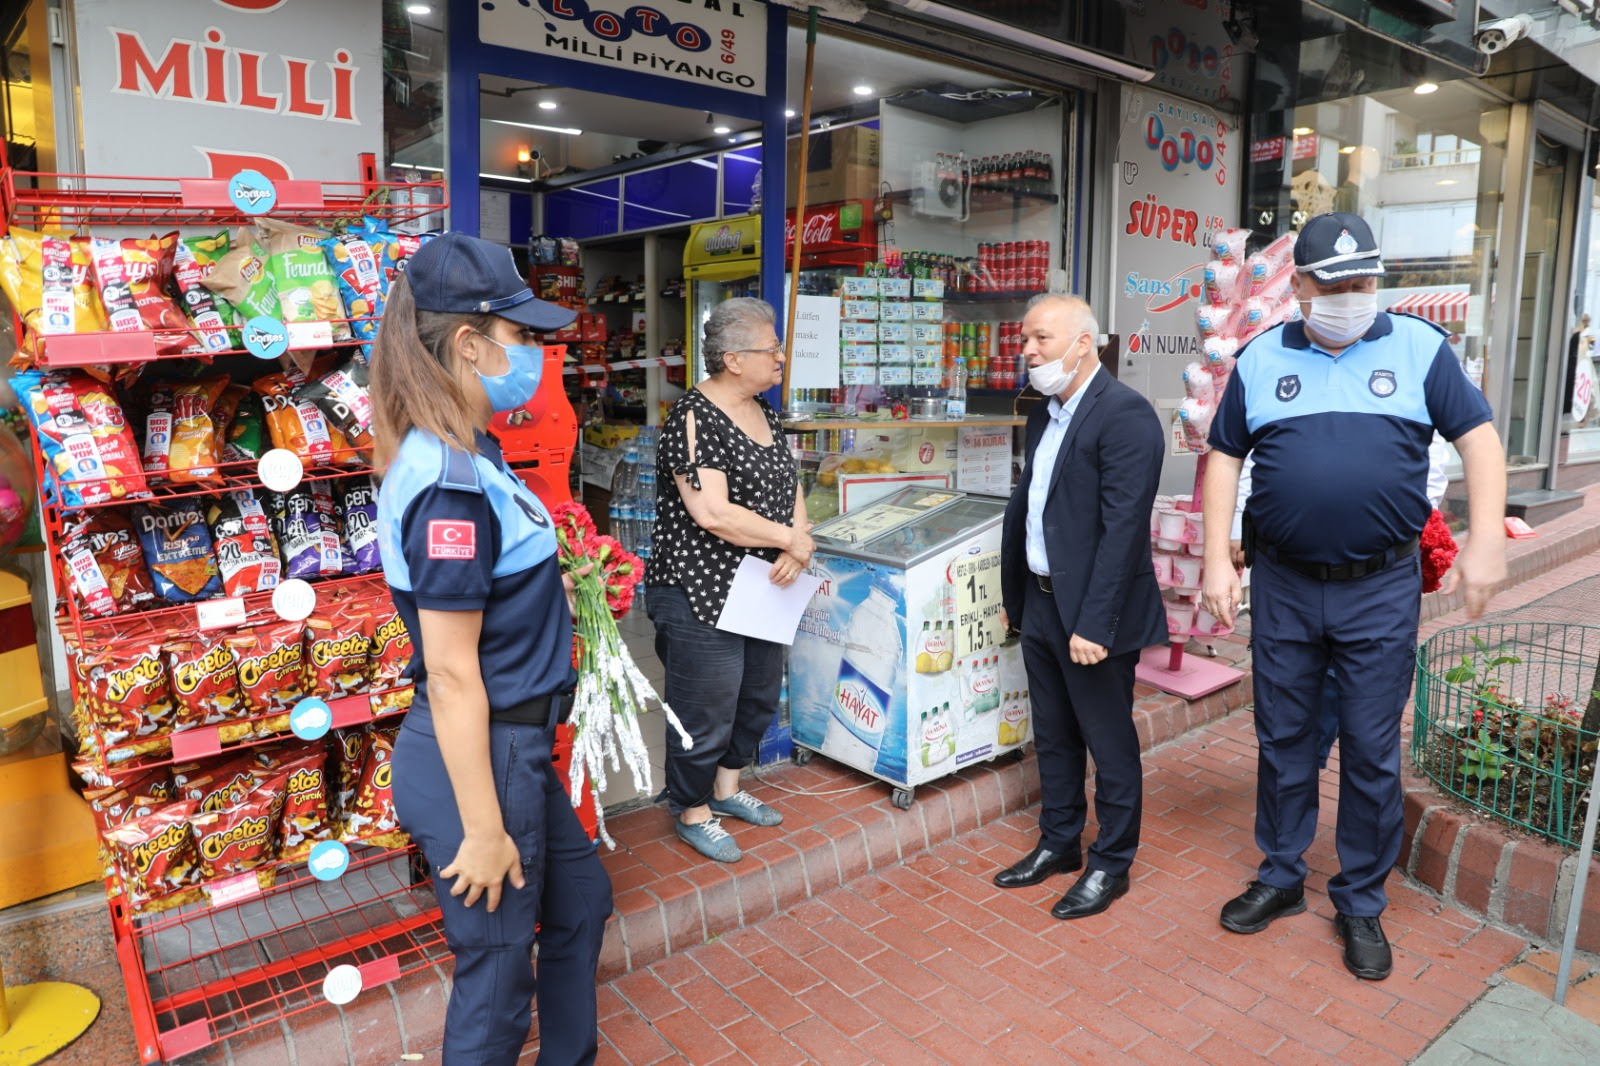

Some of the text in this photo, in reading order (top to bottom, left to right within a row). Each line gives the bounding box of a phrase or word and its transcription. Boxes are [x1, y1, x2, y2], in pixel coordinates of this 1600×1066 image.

[552, 0, 700, 48] LOTO
[720, 28, 736, 64] 6/49
[545, 33, 755, 88] MİLLİ PİYANGO
[108, 26, 361, 126] MİLLİ
[1157, 101, 1215, 128] SAYISAL
[1146, 115, 1213, 168] LOTO
[1215, 119, 1229, 186] 6/49
[234, 189, 272, 200] Doritos
[1126, 193, 1198, 247] SÜPER
[353, 252, 370, 261] YOK
[1124, 271, 1172, 298] Şans
[796, 311, 820, 321] Lütfen
[248, 332, 284, 344] Doritos
[795, 331, 819, 340] maske
[1156, 335, 1200, 355] NUMA
[302, 412, 320, 422] YOK
[72, 450, 94, 460] YOK
[141, 509, 206, 533] Doritos
[157, 546, 208, 562] EXTREME
[434, 545, 471, 556] TÜRKİYE
[76, 561, 94, 573] YOK
[263, 567, 279, 575] YOK
[966, 575, 988, 603] 1 TL
[312, 633, 369, 667] Cheetos
[967, 621, 984, 653] 1.5
[108, 655, 162, 702] Cheeto
[176, 646, 234, 692] Cheetos
[239, 643, 301, 687] Cheetos
[839, 688, 880, 729] HAYAT
[202, 817, 268, 859] Cheetos
